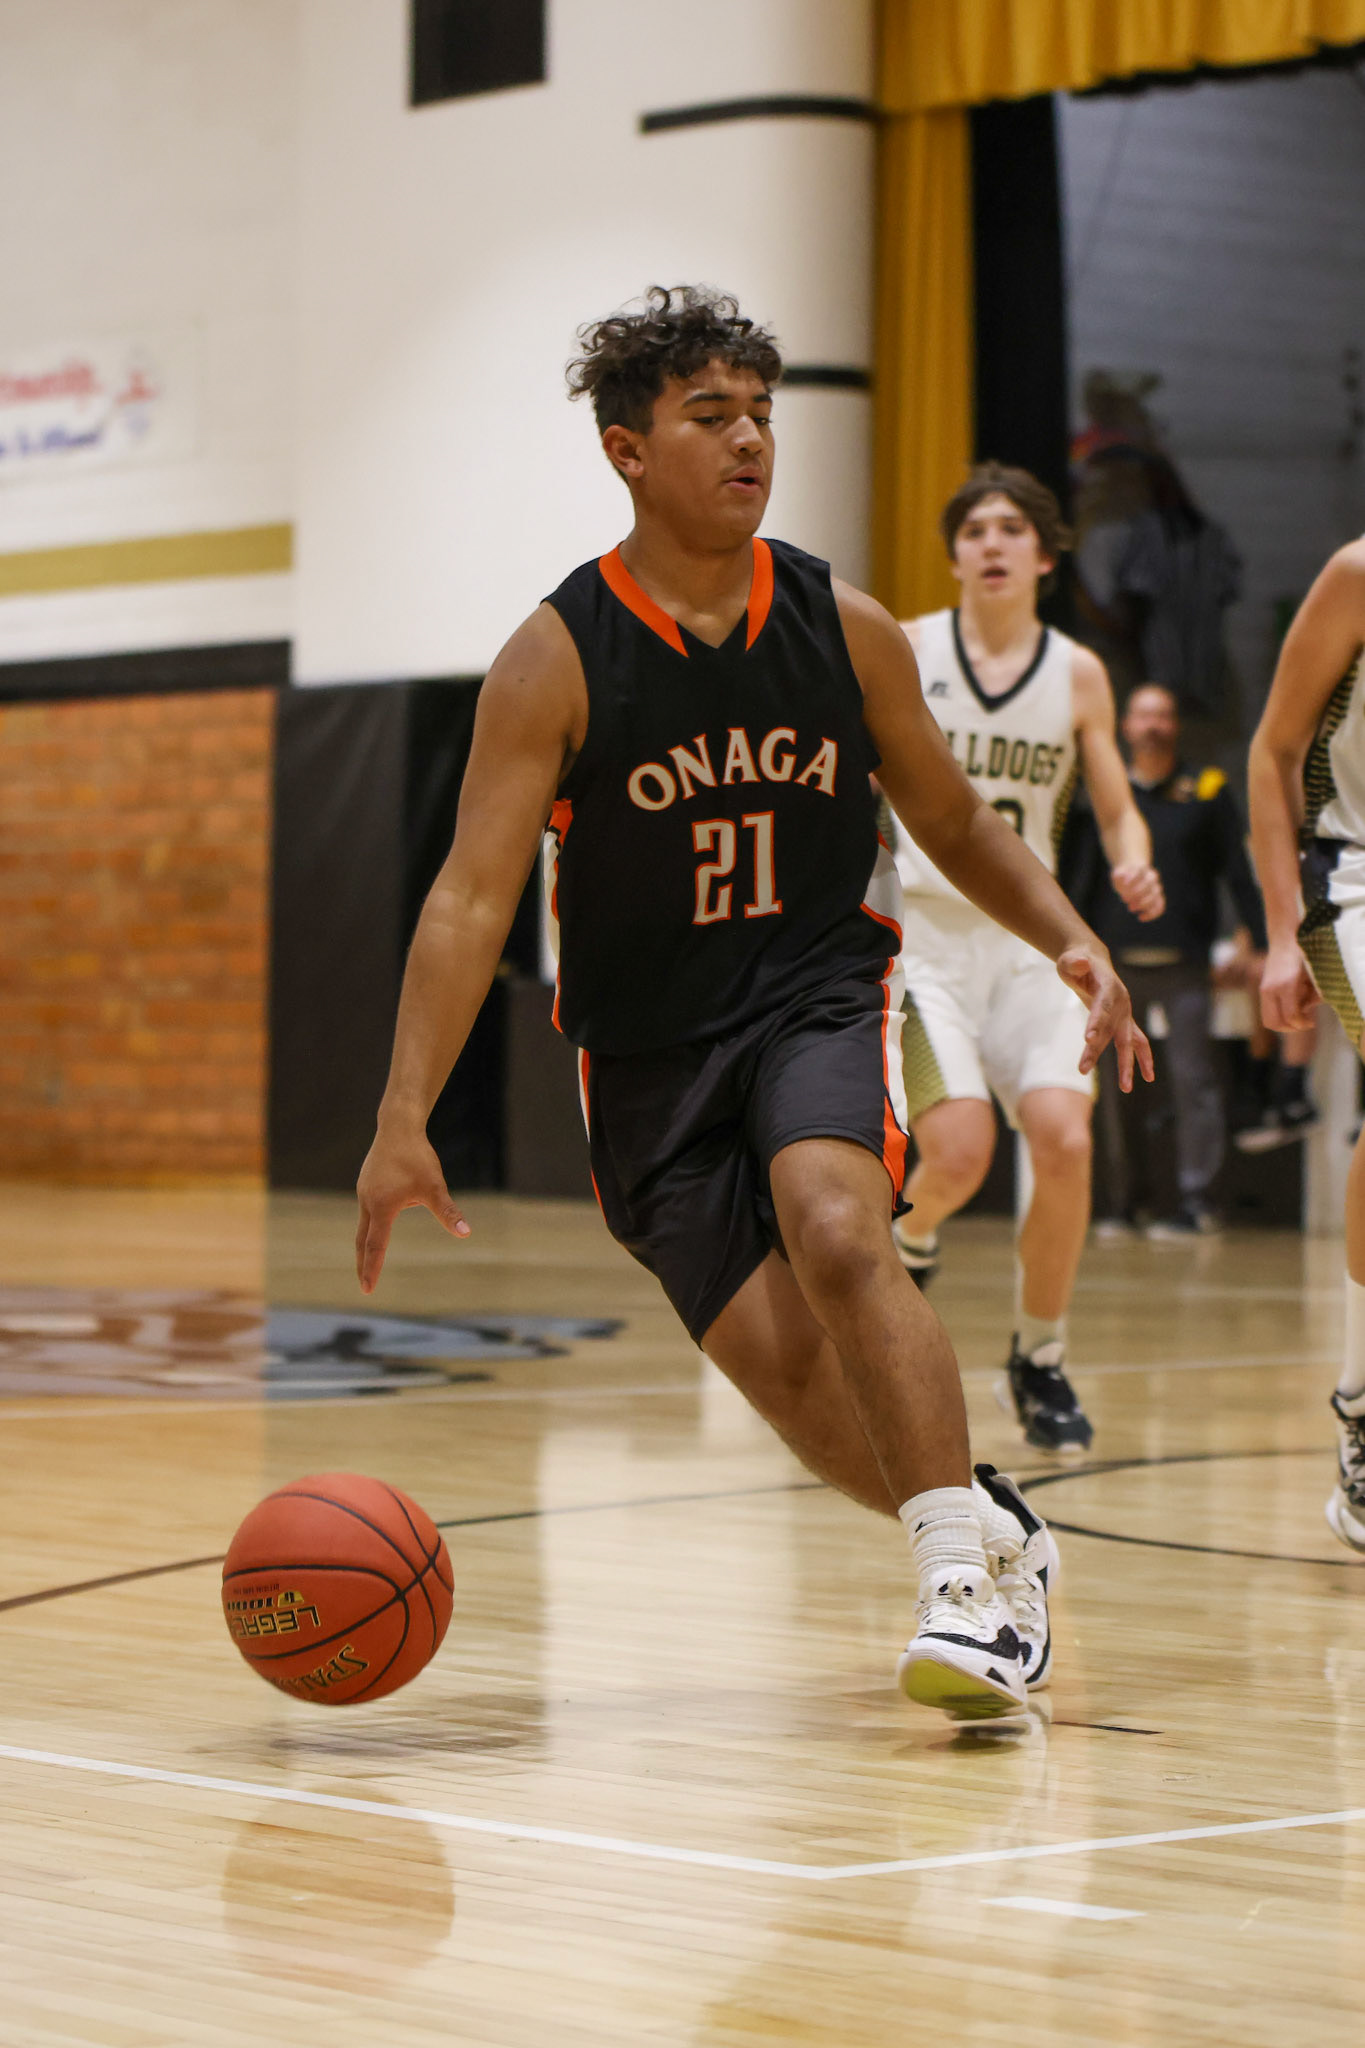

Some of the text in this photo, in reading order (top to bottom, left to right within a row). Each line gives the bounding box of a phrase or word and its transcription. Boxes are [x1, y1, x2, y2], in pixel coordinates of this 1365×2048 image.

[627, 726, 838, 811] ONAGA
[945, 730, 1064, 787] LDOGS
[691, 810, 783, 925] 21
[231, 1604, 321, 1639] LEGAC
[272, 1643, 370, 1692] SPAL
